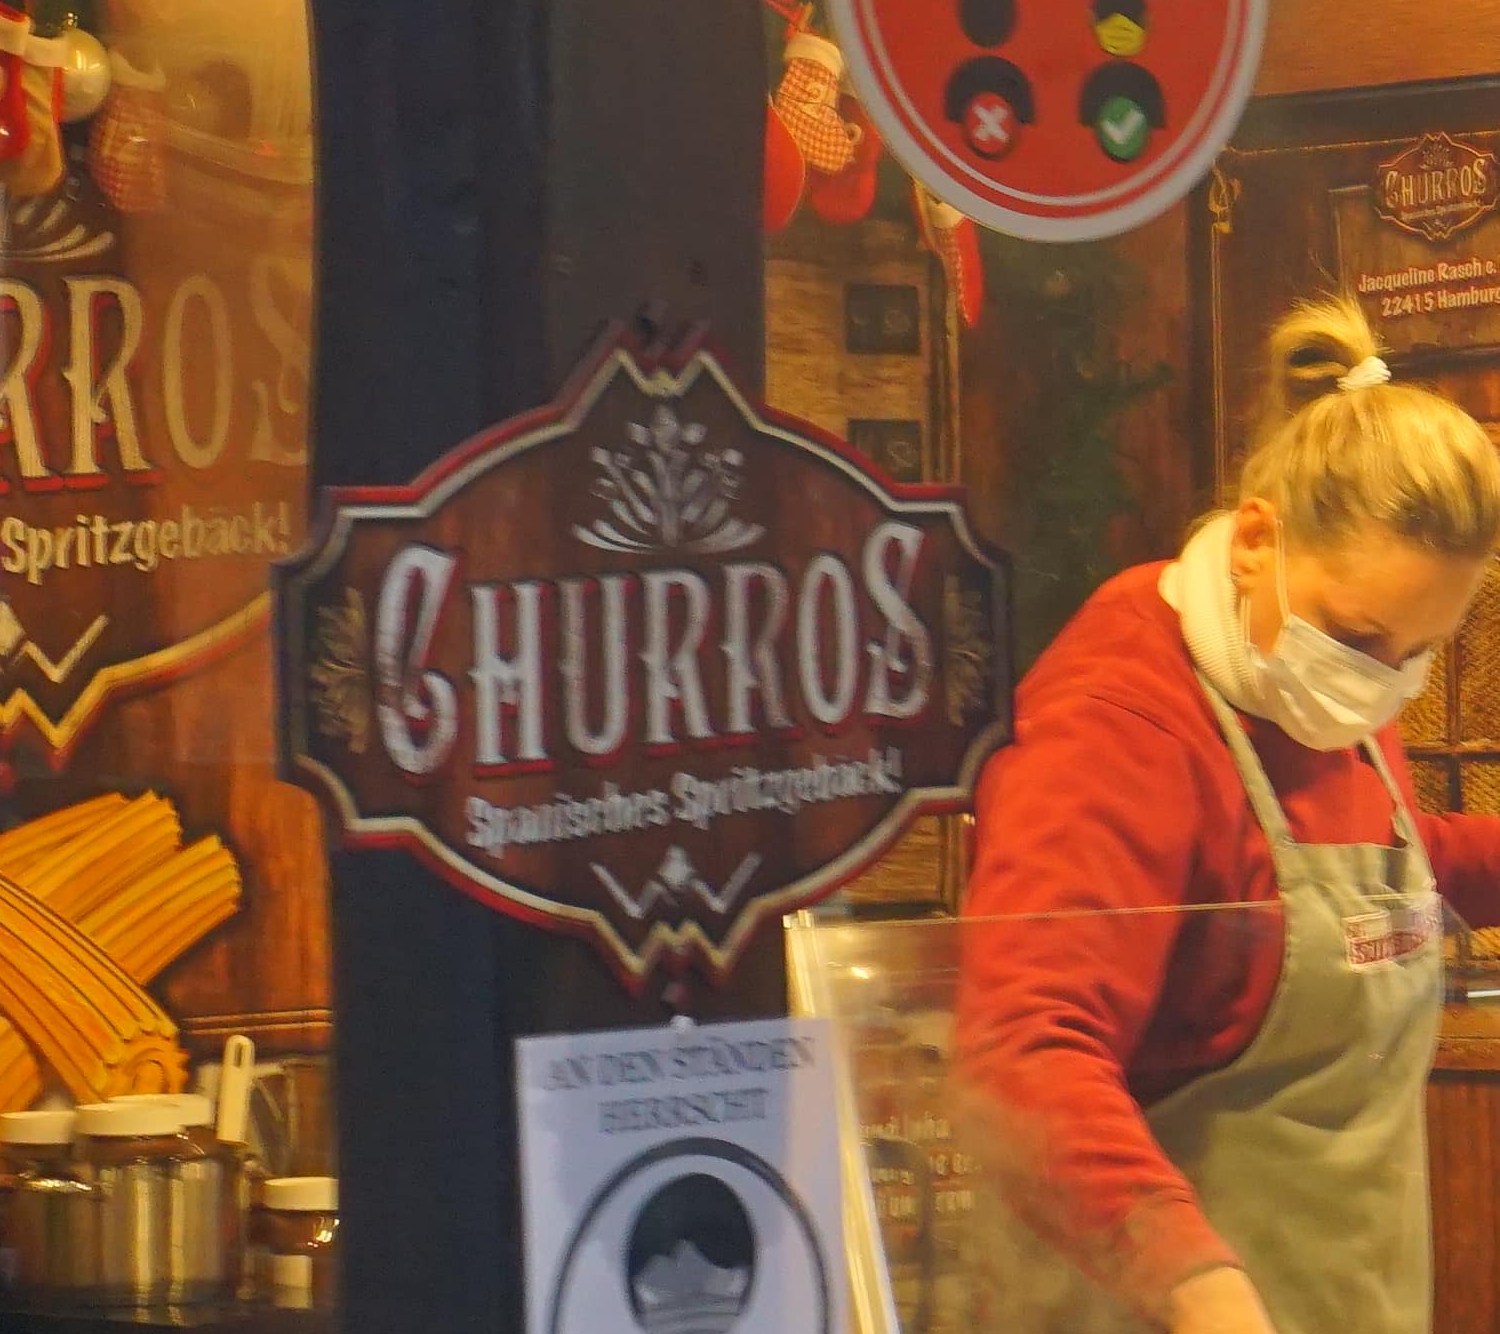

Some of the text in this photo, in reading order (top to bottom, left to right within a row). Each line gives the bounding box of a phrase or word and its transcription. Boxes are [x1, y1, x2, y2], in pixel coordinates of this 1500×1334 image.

[1385, 157, 1488, 209] CHURROS
[1358, 267, 1435, 293] Jacqueline
[1436, 257, 1483, 282] Rasch
[1381, 291, 1436, 317] 22415
[0, 501, 293, 584] Spritzgebäck!
[374, 520, 934, 777] CHURROS
